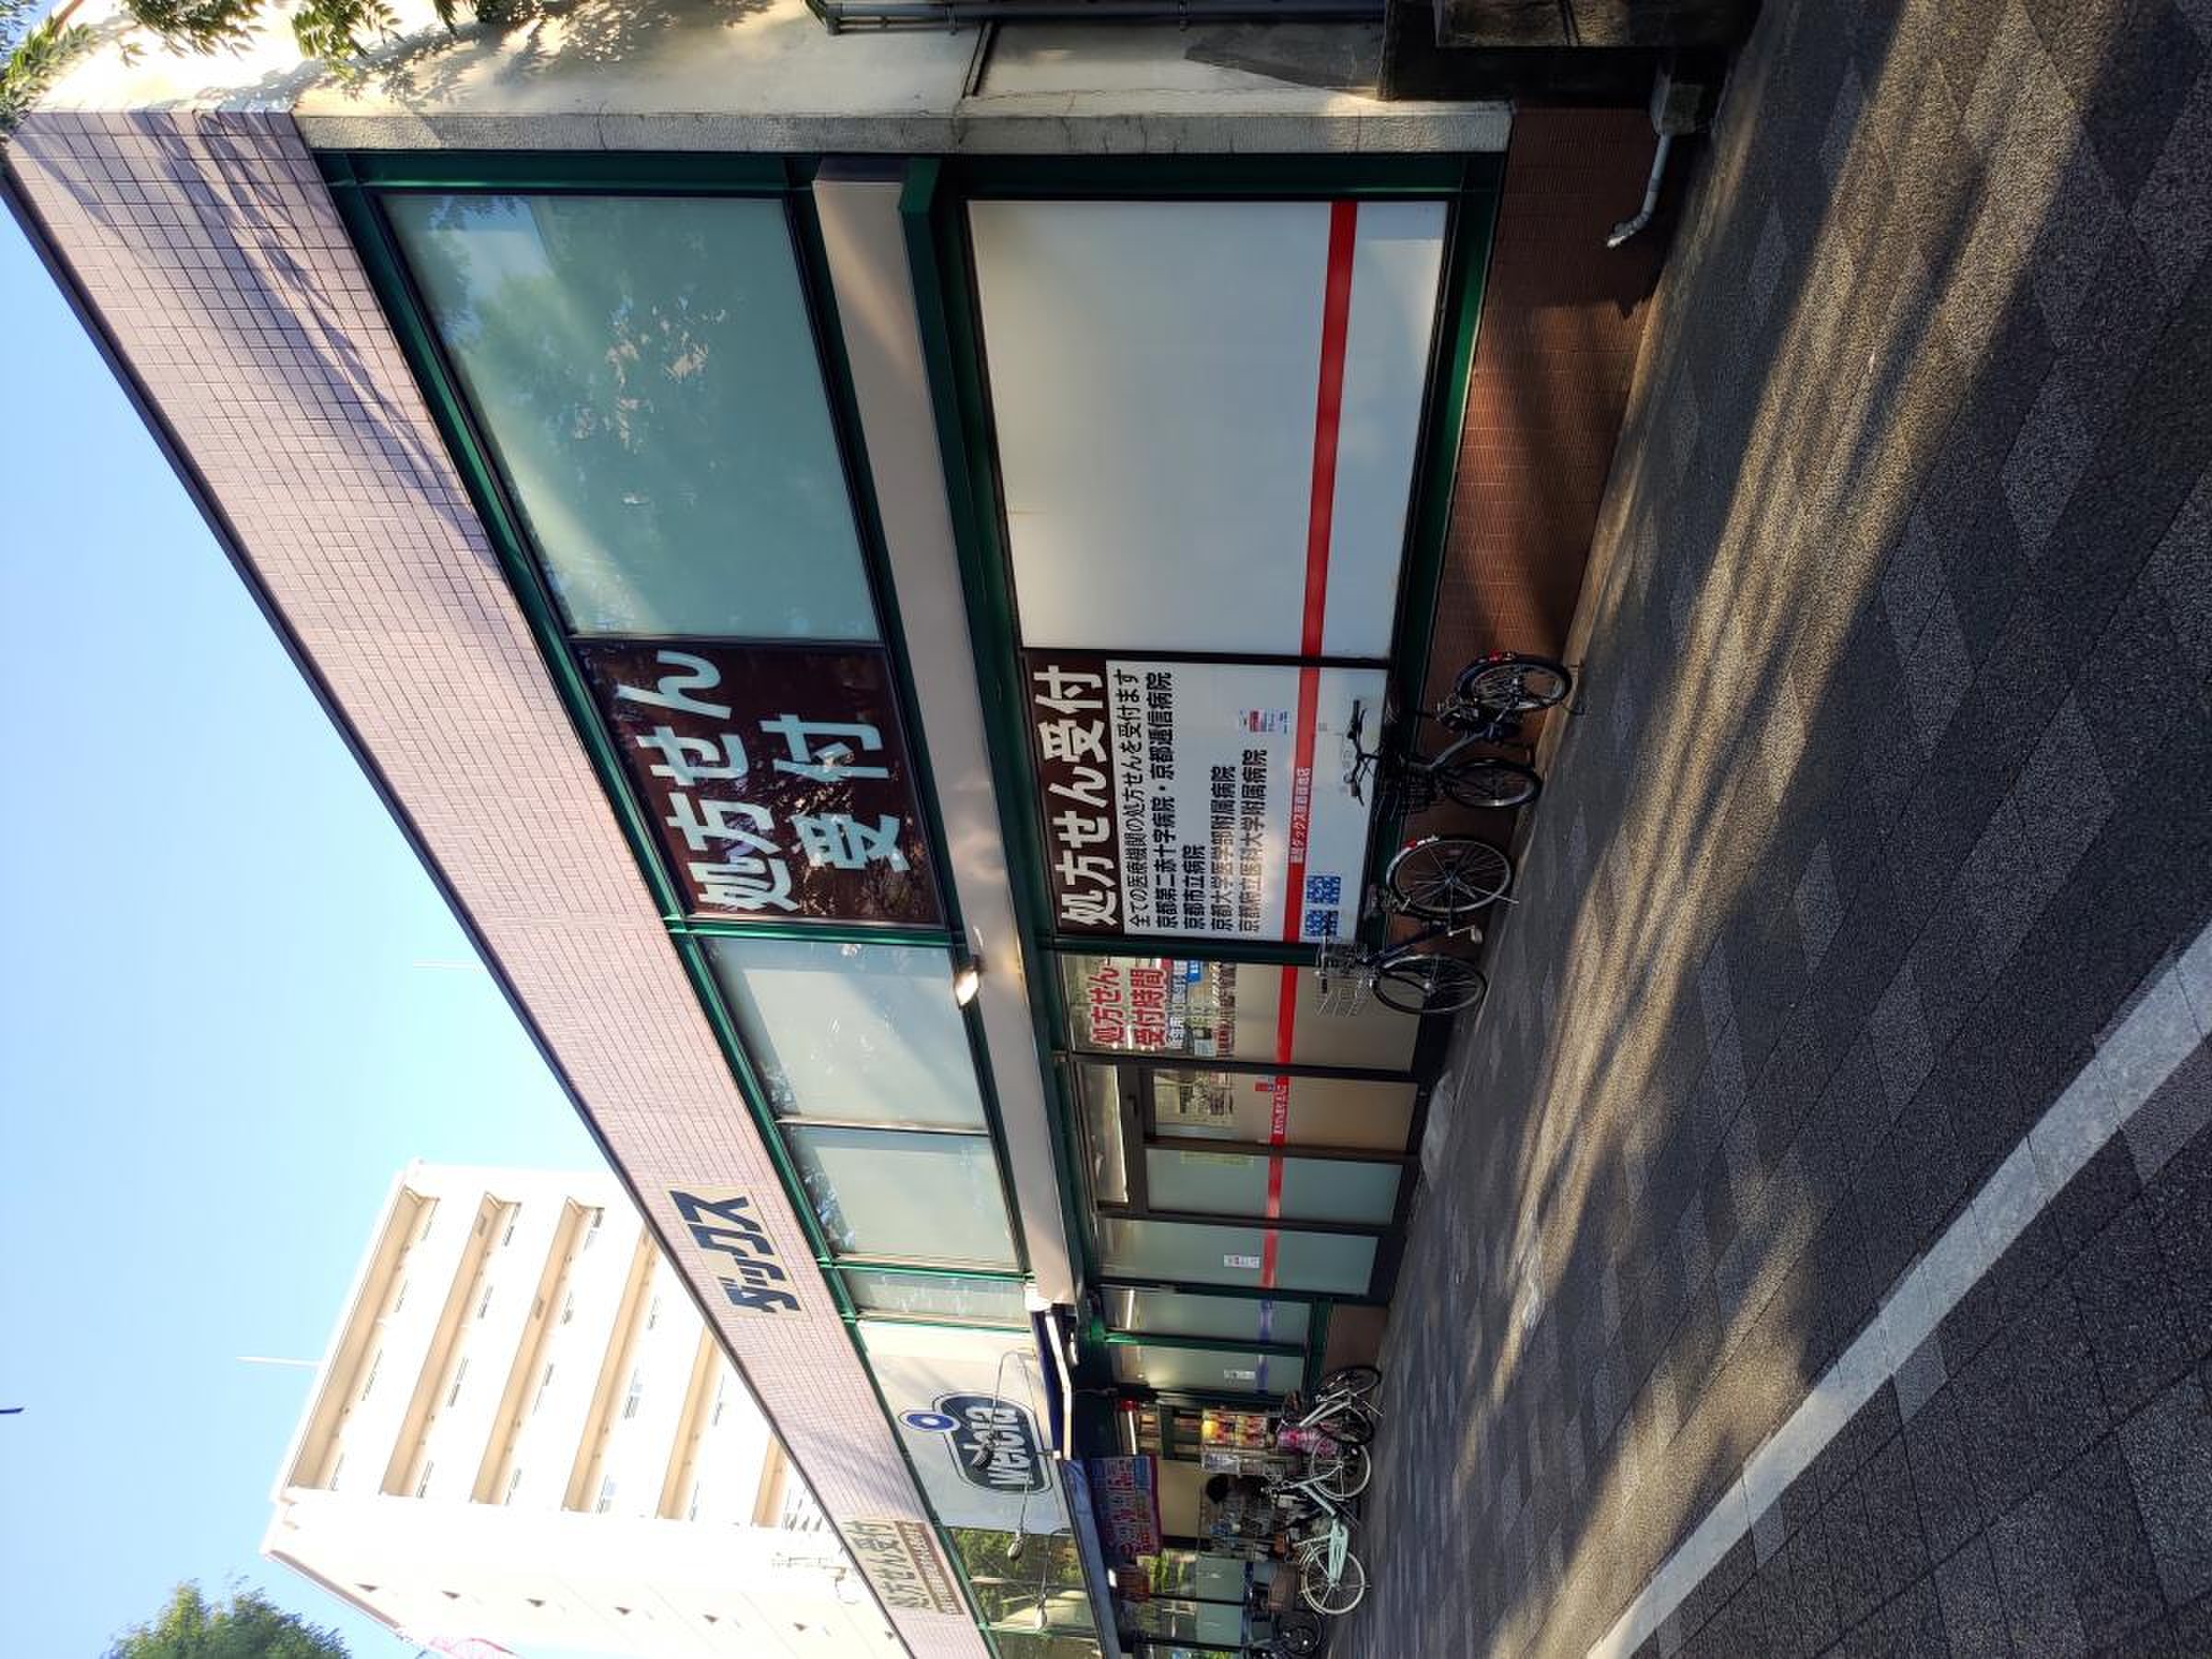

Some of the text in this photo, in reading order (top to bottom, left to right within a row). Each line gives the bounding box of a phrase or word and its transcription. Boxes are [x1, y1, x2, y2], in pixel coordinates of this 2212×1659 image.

[617, 650, 799, 912] 処方せん
[759, 714, 911, 872] 受付
[1033, 665, 1119, 925] 処方せん受付
[1113, 668, 1150, 927] 全ての医療機関の処方せんを受付ます
[1210, 765, 1236, 932] 京都大学医学部附属病院
[1238, 748, 1267, 933] 京都府立医科大学附属病院
[1182, 844, 1206, 930] 京都市立病院
[1089, 967, 1126, 1043] 処方せん
[1130, 968, 1166, 1046] 受付時間
[669, 1191, 801, 1312] ダックス
